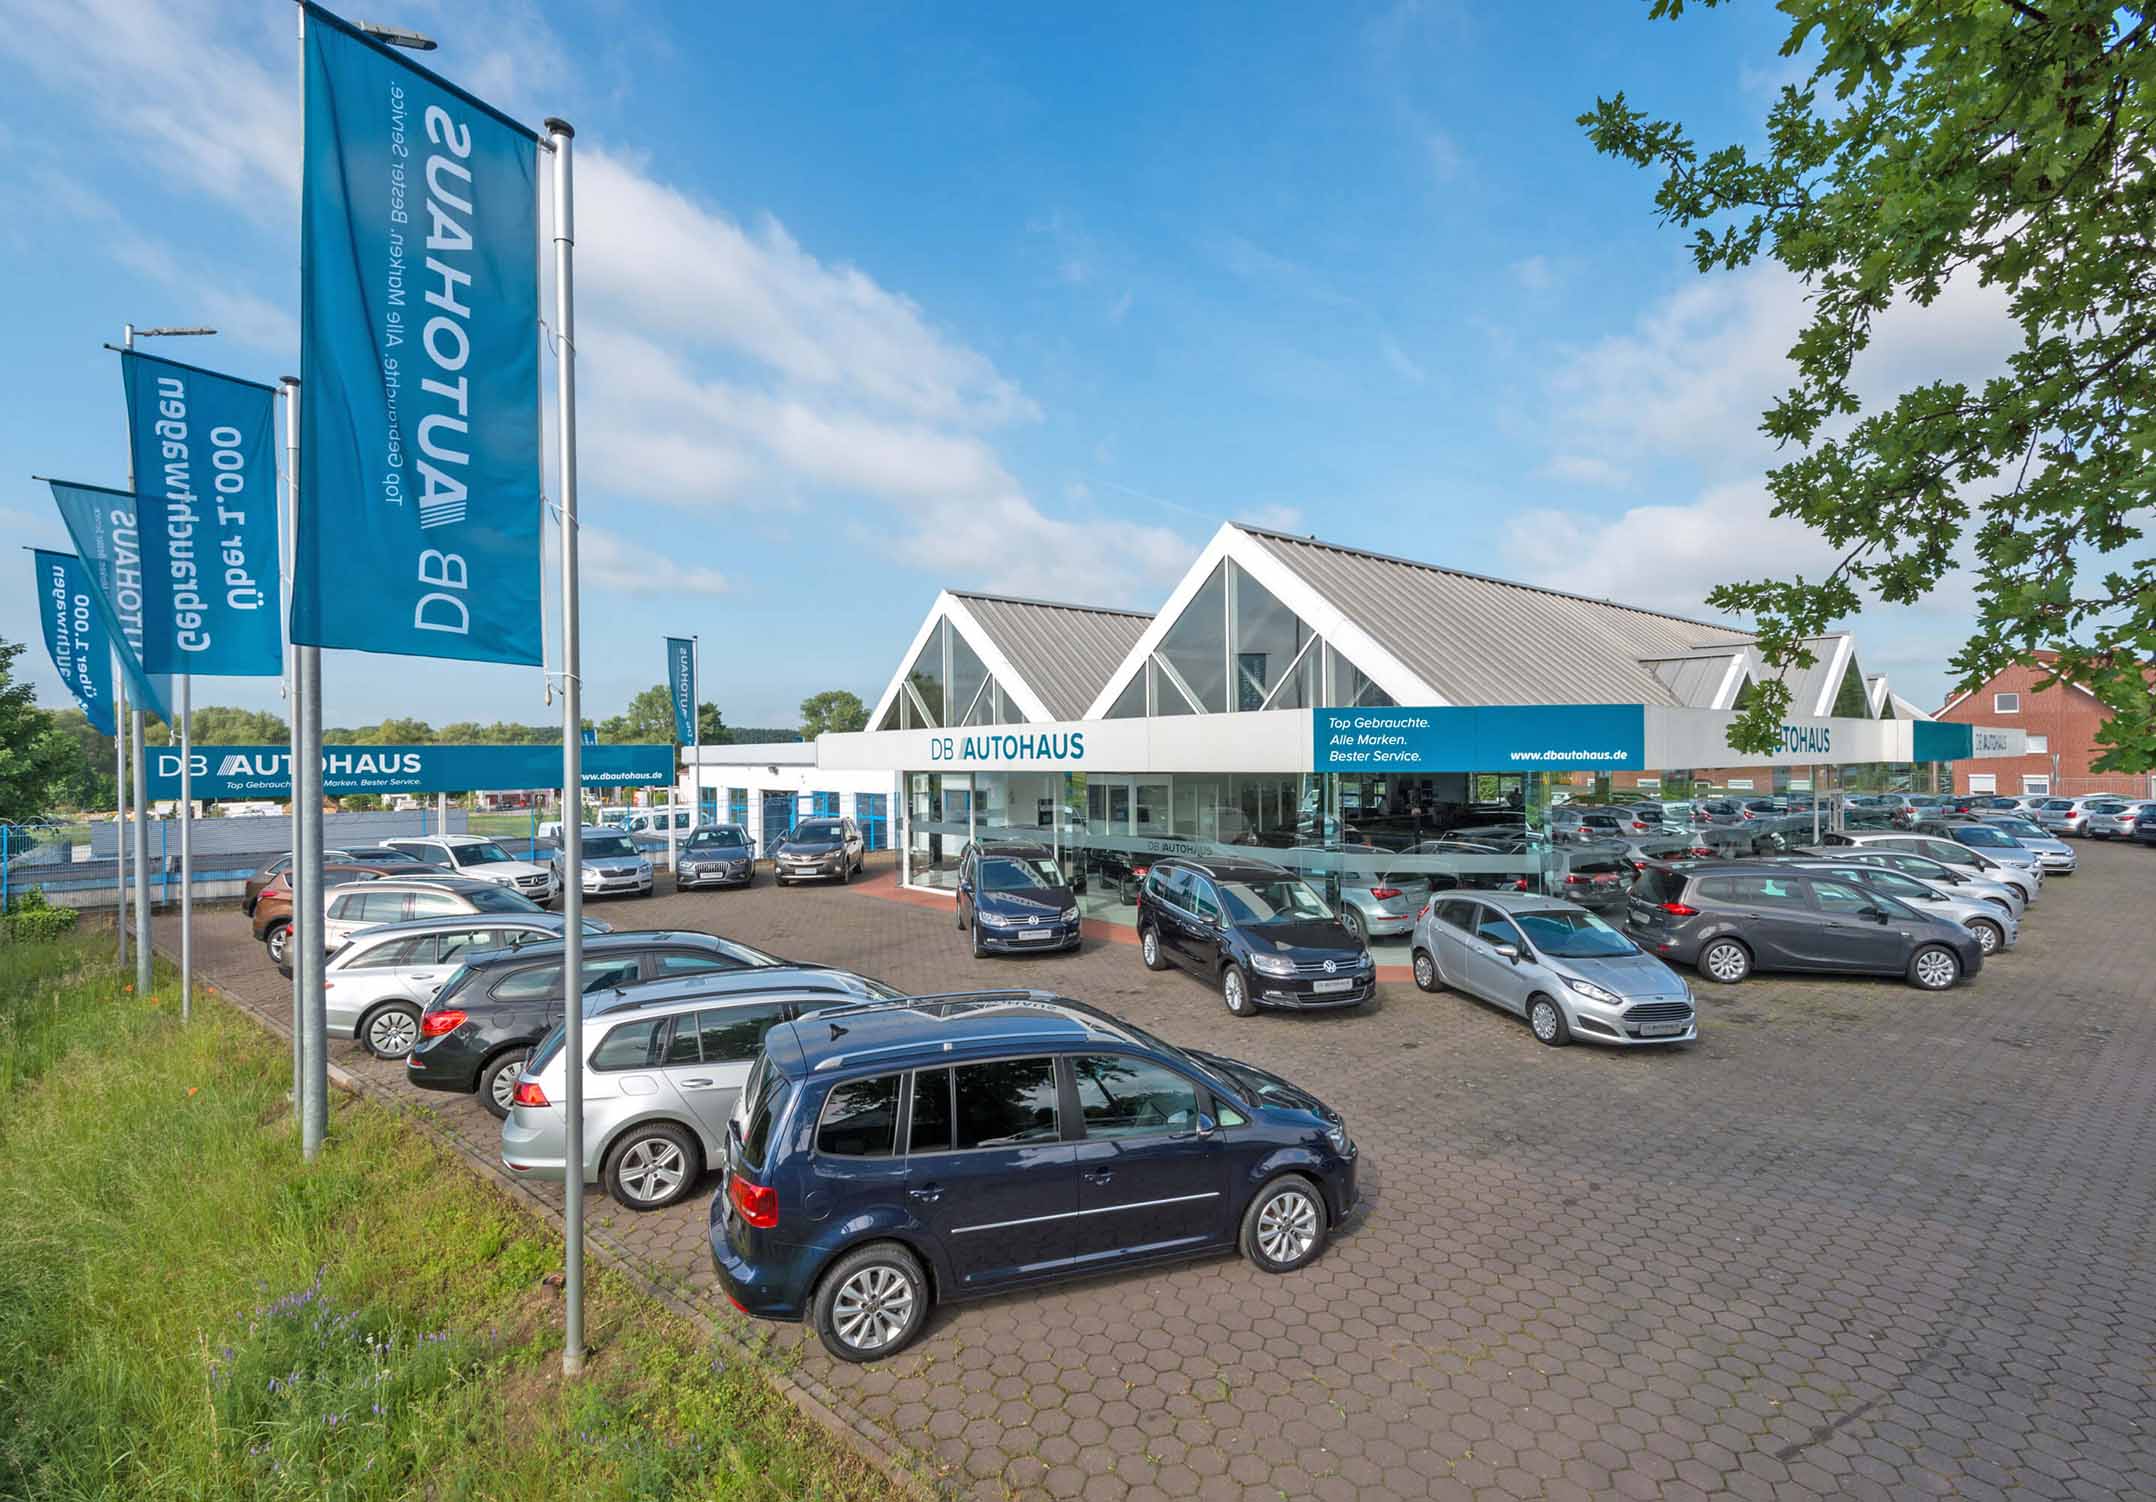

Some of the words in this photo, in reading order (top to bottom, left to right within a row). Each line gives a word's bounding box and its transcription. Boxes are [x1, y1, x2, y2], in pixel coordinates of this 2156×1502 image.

[1328, 717, 1351, 729] Top
[1354, 716, 1431, 729] Gebrauchte.
[1329, 733, 1354, 745] Alle
[1357, 733, 1407, 745] Marken.
[1769, 726, 1830, 753] UTOHAUS
[930, 738, 953, 761] DB
[963, 732, 1085, 760] AUTOHAUS
[1329, 750, 1371, 762] Bester
[1373, 749, 1422, 762] Service.
[1510, 749, 1628, 761] www.dbautohaus.de
[228, 753, 422, 776] AUTHAUS
[580, 771, 663, 781] ww.dbautohaus.de
[225, 781, 244, 790] Top
[246, 780, 292, 789] Gebrauch
[360, 778, 389, 786] Bester
